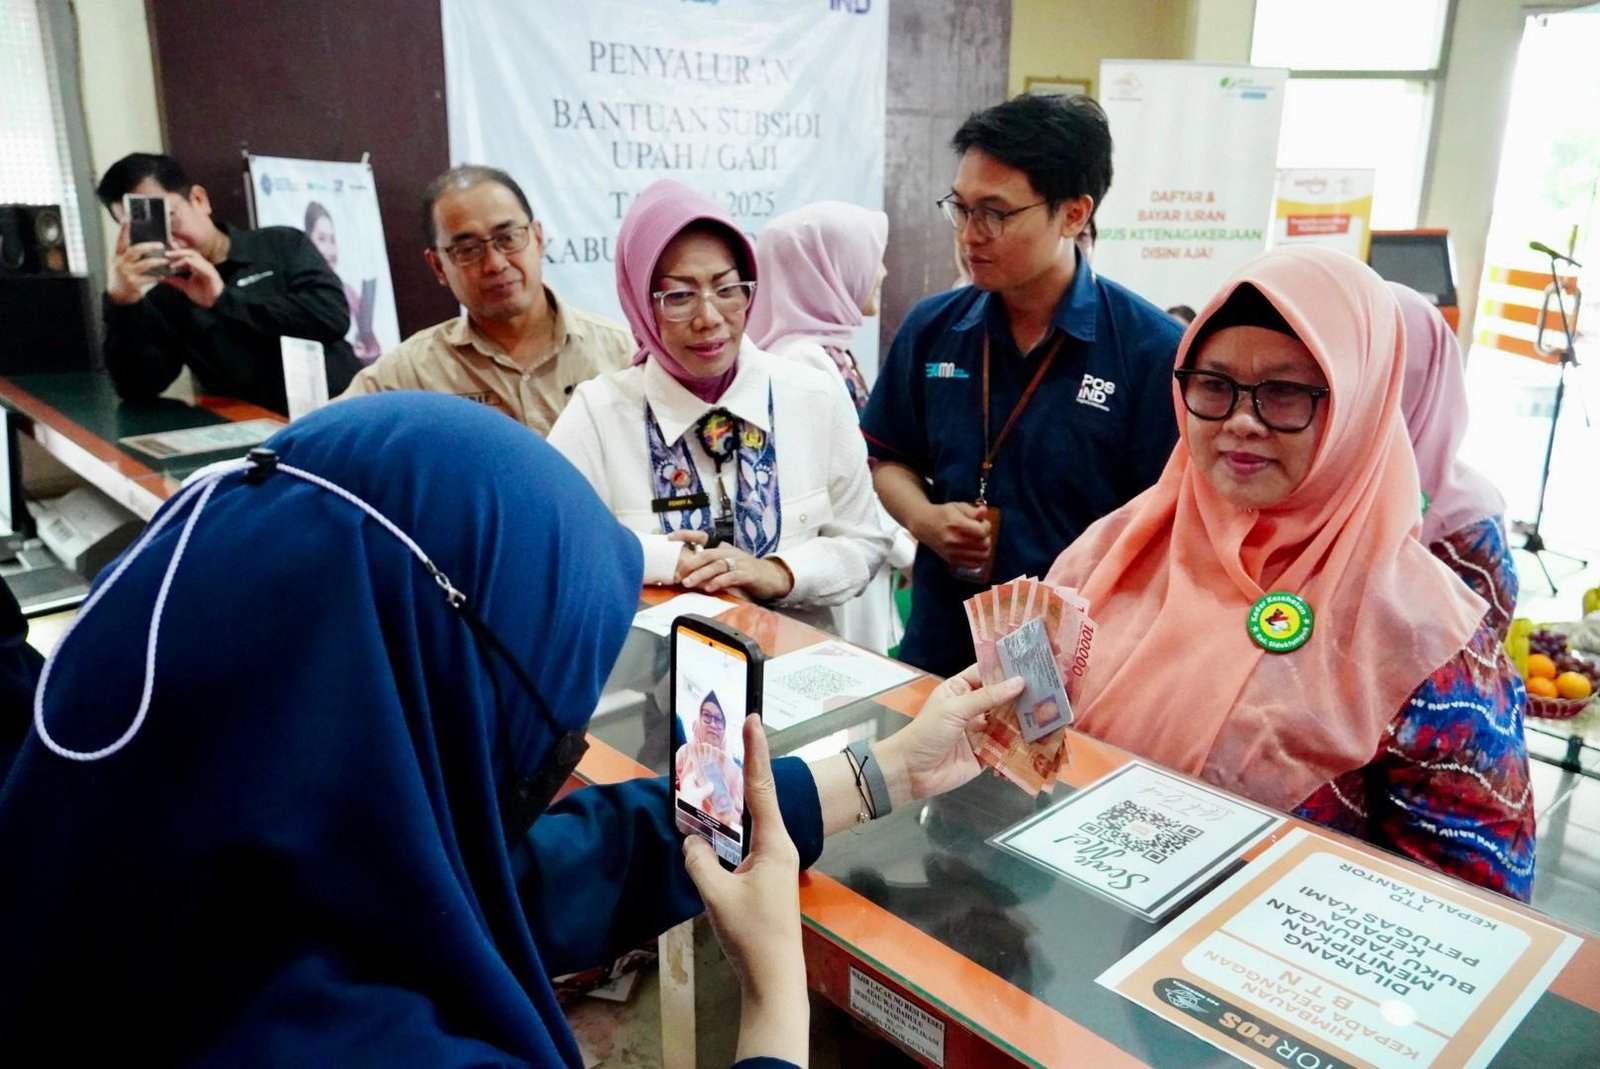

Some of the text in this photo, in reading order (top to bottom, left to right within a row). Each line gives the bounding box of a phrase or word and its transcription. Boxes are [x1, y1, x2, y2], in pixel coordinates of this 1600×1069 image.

[589, 41, 797, 87] PENYALURAN
[553, 99, 821, 139] BANTUAN SUBSIDI
[611, 141, 694, 170] UPAH
[717, 142, 778, 172] GAJI
[729, 192, 776, 217] 2025
[1138, 209, 1226, 222] BAYAR IURAN
[1151, 190, 1202, 203] DAFTAR
[1130, 228, 1264, 241] KETENAGAKERJAAN
[1141, 247, 1180, 259] DISINI
[1081, 373, 1116, 395] POS
[1071, 623, 1094, 677] 100000
[1339, 862, 1498, 931] KEPALA KANTOR
[1389, 894, 1425, 913] TTD
[1266, 898, 1476, 995] BUKU TABUNGAN
[1299, 886, 1480, 967] PETUGAS KAMI
[1330, 911, 1426, 958] KEPADA
[1281, 918, 1435, 992] MENITIPKAN
[1283, 933, 1412, 996] DILARANG
[1203, 950, 1420, 1060] KEPADA PELANGGAN
[1241, 981, 1355, 1042] HIMBAUAN
